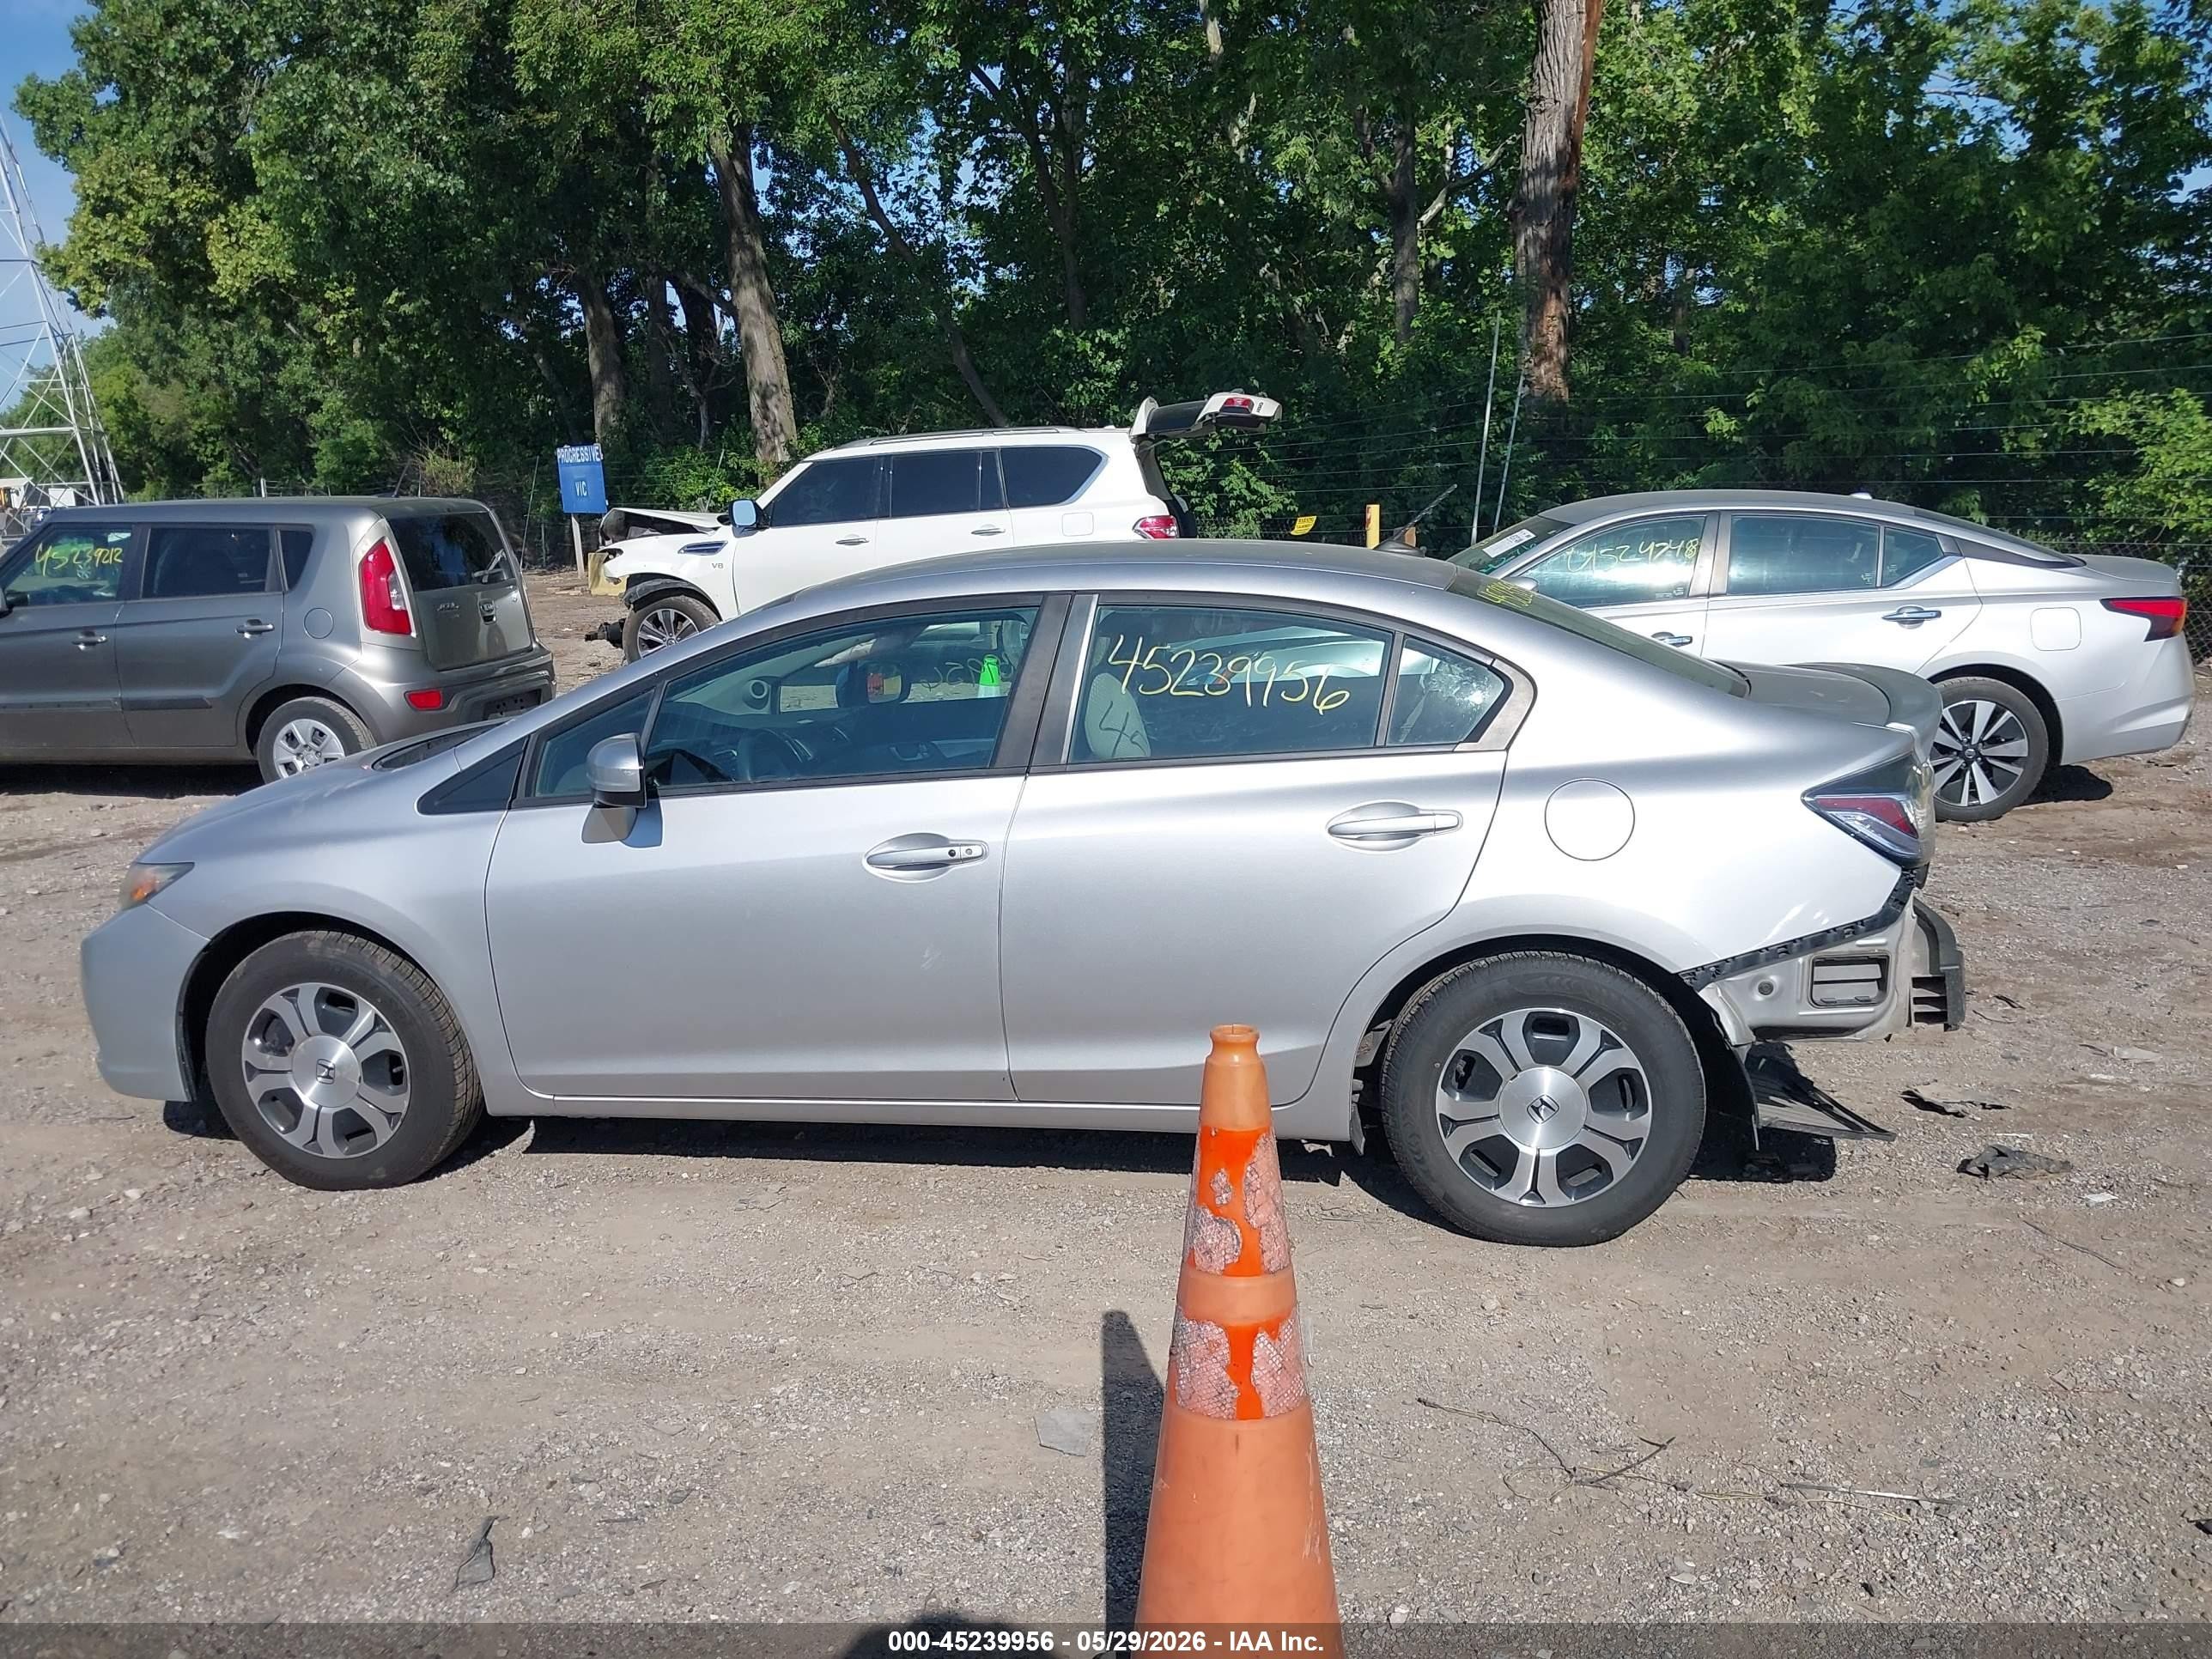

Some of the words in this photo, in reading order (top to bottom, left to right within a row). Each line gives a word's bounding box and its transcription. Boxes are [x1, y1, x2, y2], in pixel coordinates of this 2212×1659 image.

[557, 446, 601, 464] PROGRESSIVE
[574, 480, 587, 497] VIC
[35, 542, 124, 577] 45239212
[1108, 634, 1351, 716] 45239956
